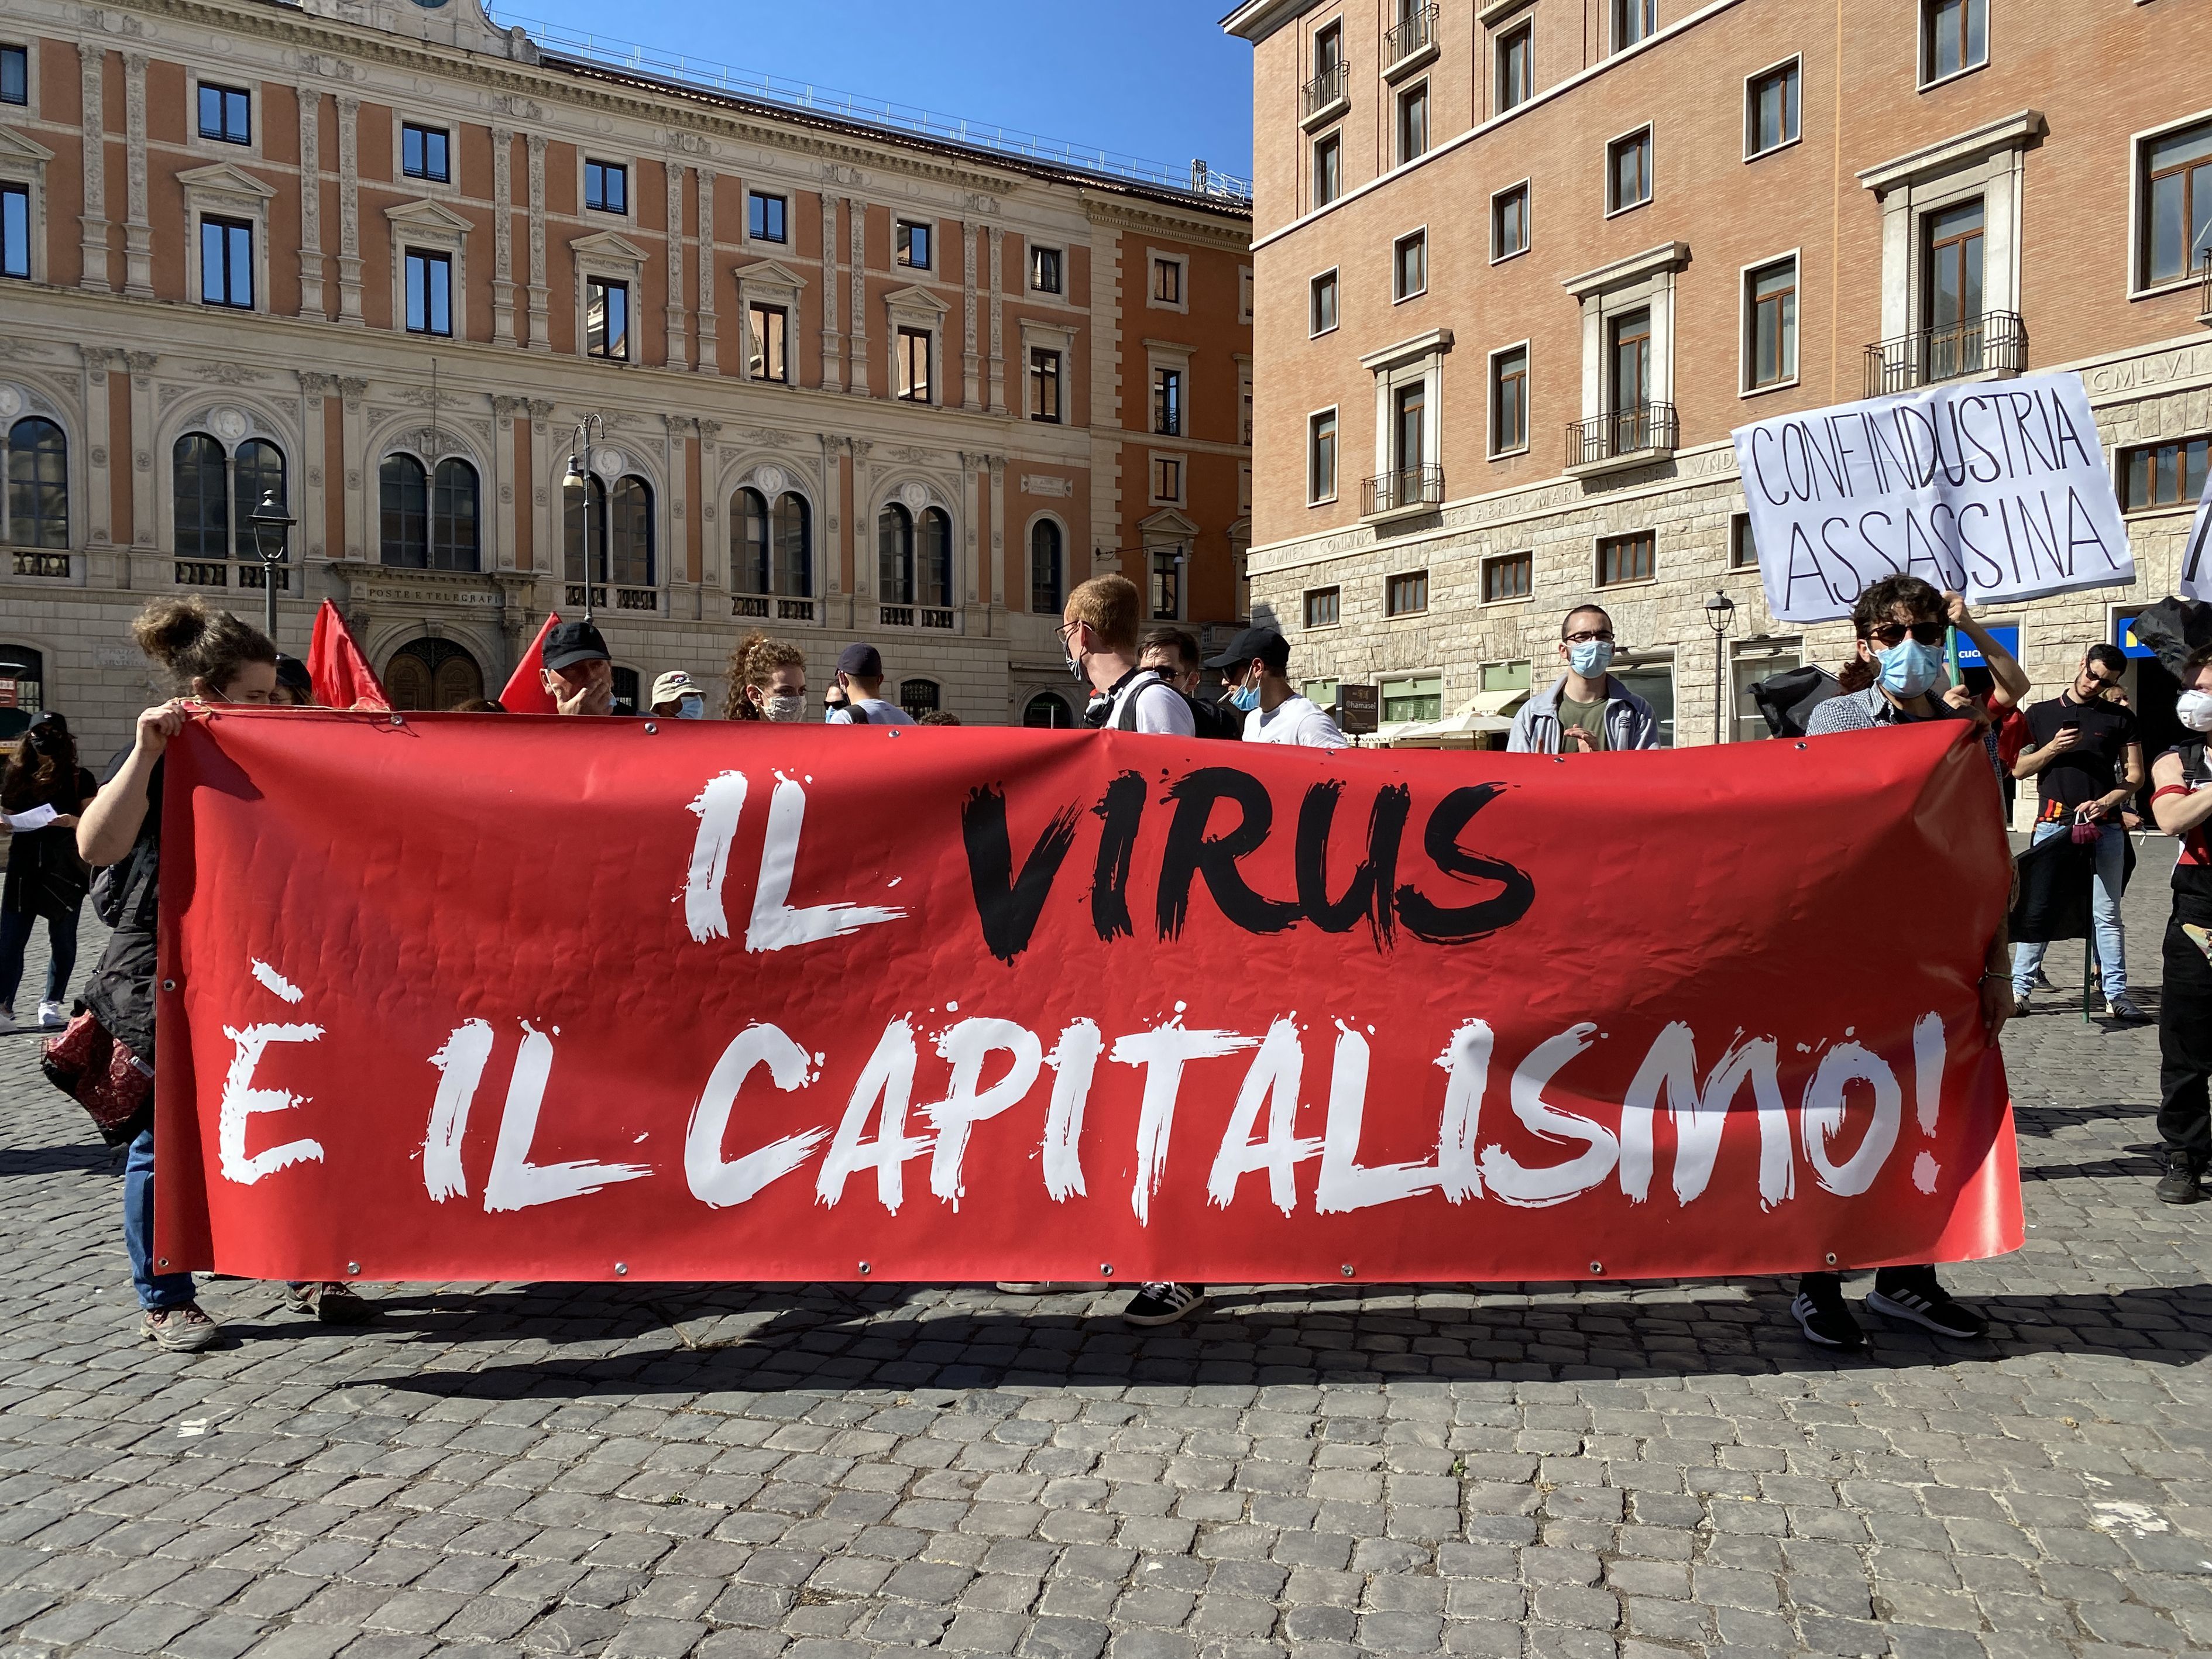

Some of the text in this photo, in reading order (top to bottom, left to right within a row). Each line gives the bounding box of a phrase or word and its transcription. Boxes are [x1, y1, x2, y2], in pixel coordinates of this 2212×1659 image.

[1751, 387, 2090, 506] CONFINDUSTRIA
[1268, 545, 1304, 565] OMNES
[1476, 497, 1521, 521] AERIS
[1695, 454, 1739, 475] VND
[1784, 486, 2120, 612] ASSASSINA
[369, 589, 410, 598] POSTE
[426, 592, 497, 603] TELEGRAFI
[682, 767, 1536, 968] IL VIRUS
[218, 957, 1947, 1228] È IL CAPITALISMO!
